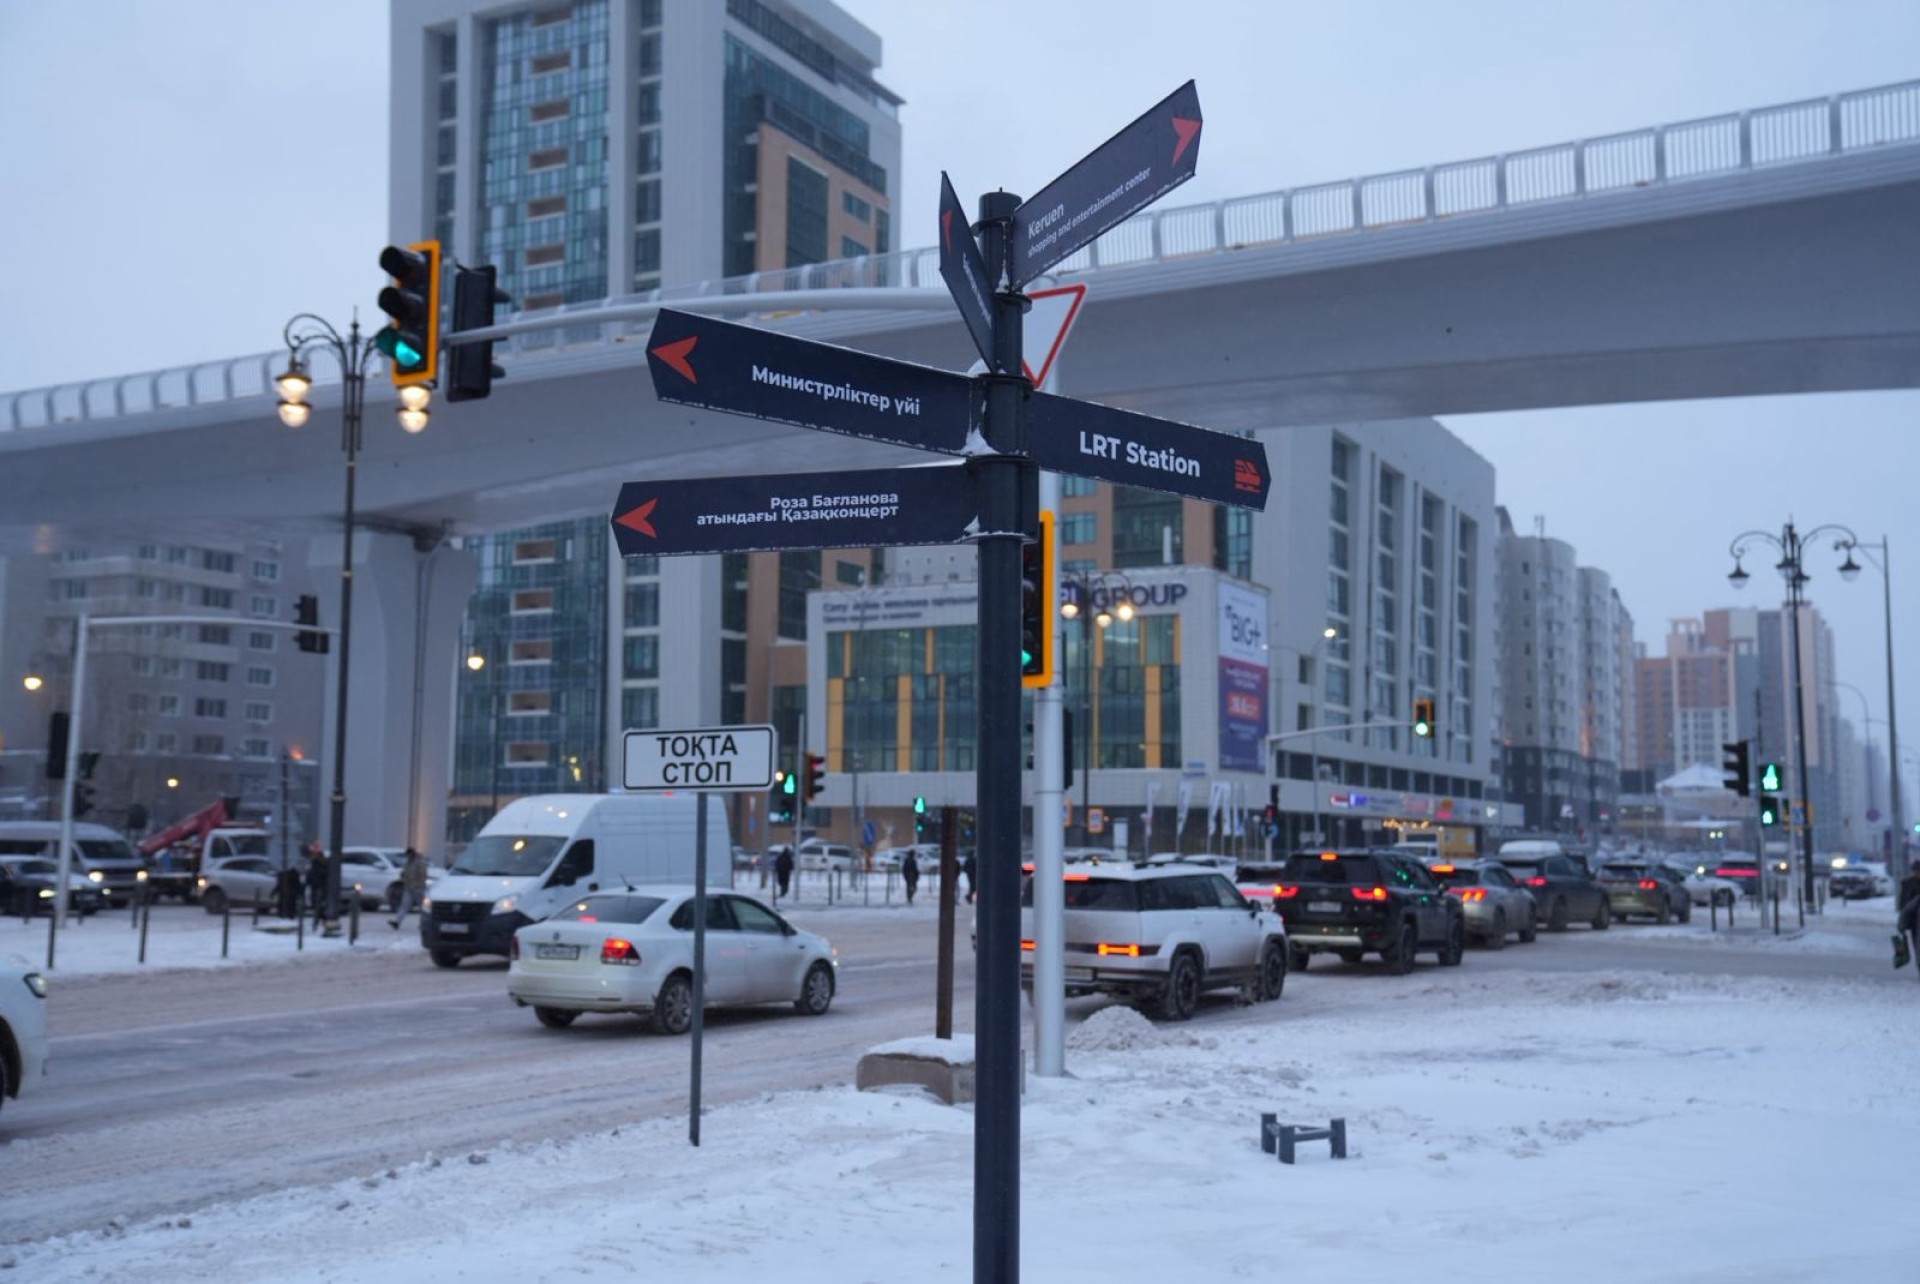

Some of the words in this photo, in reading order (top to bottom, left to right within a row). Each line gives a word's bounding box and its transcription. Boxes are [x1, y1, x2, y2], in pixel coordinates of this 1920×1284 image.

[1028, 231, 1057, 258] shopping
[1058, 219, 1071, 237] and
[1072, 185, 1124, 228] entertainment
[1125, 167, 1151, 191] center
[1028, 203, 1064, 240] Keruen
[752, 365, 890, 412] Министрліктер
[894, 396, 920, 416] үйі
[1080, 431, 1121, 460] LRT
[1126, 441, 1201, 478] Station
[770, 497, 808, 509] Роза
[812, 493, 899, 508] Бағланова
[697, 510, 777, 525] атындағы
[781, 504, 899, 522] Қазақконцерт
[1092, 583, 1188, 609] GROUP
[656, 734, 738, 760] ТОҚТА
[662, 761, 732, 783] СТОП
